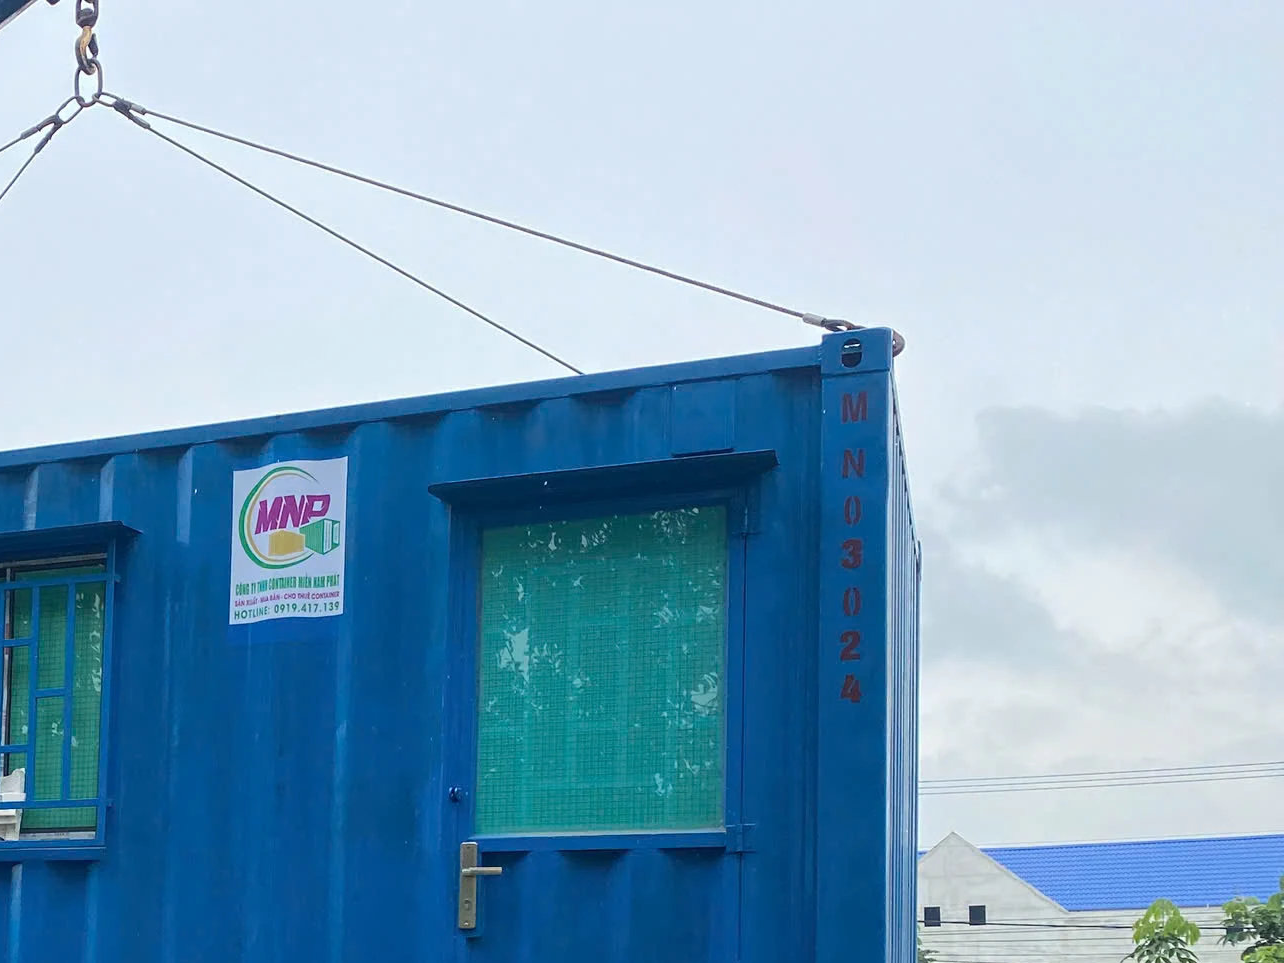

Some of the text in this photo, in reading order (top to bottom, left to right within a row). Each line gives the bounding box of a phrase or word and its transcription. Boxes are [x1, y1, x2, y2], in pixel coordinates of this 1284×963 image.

[254, 494, 331, 535] MNP
[311, 591, 340, 600] CONTAINER
[234, 601, 340, 620] HOTLINE: 0919.417.139
